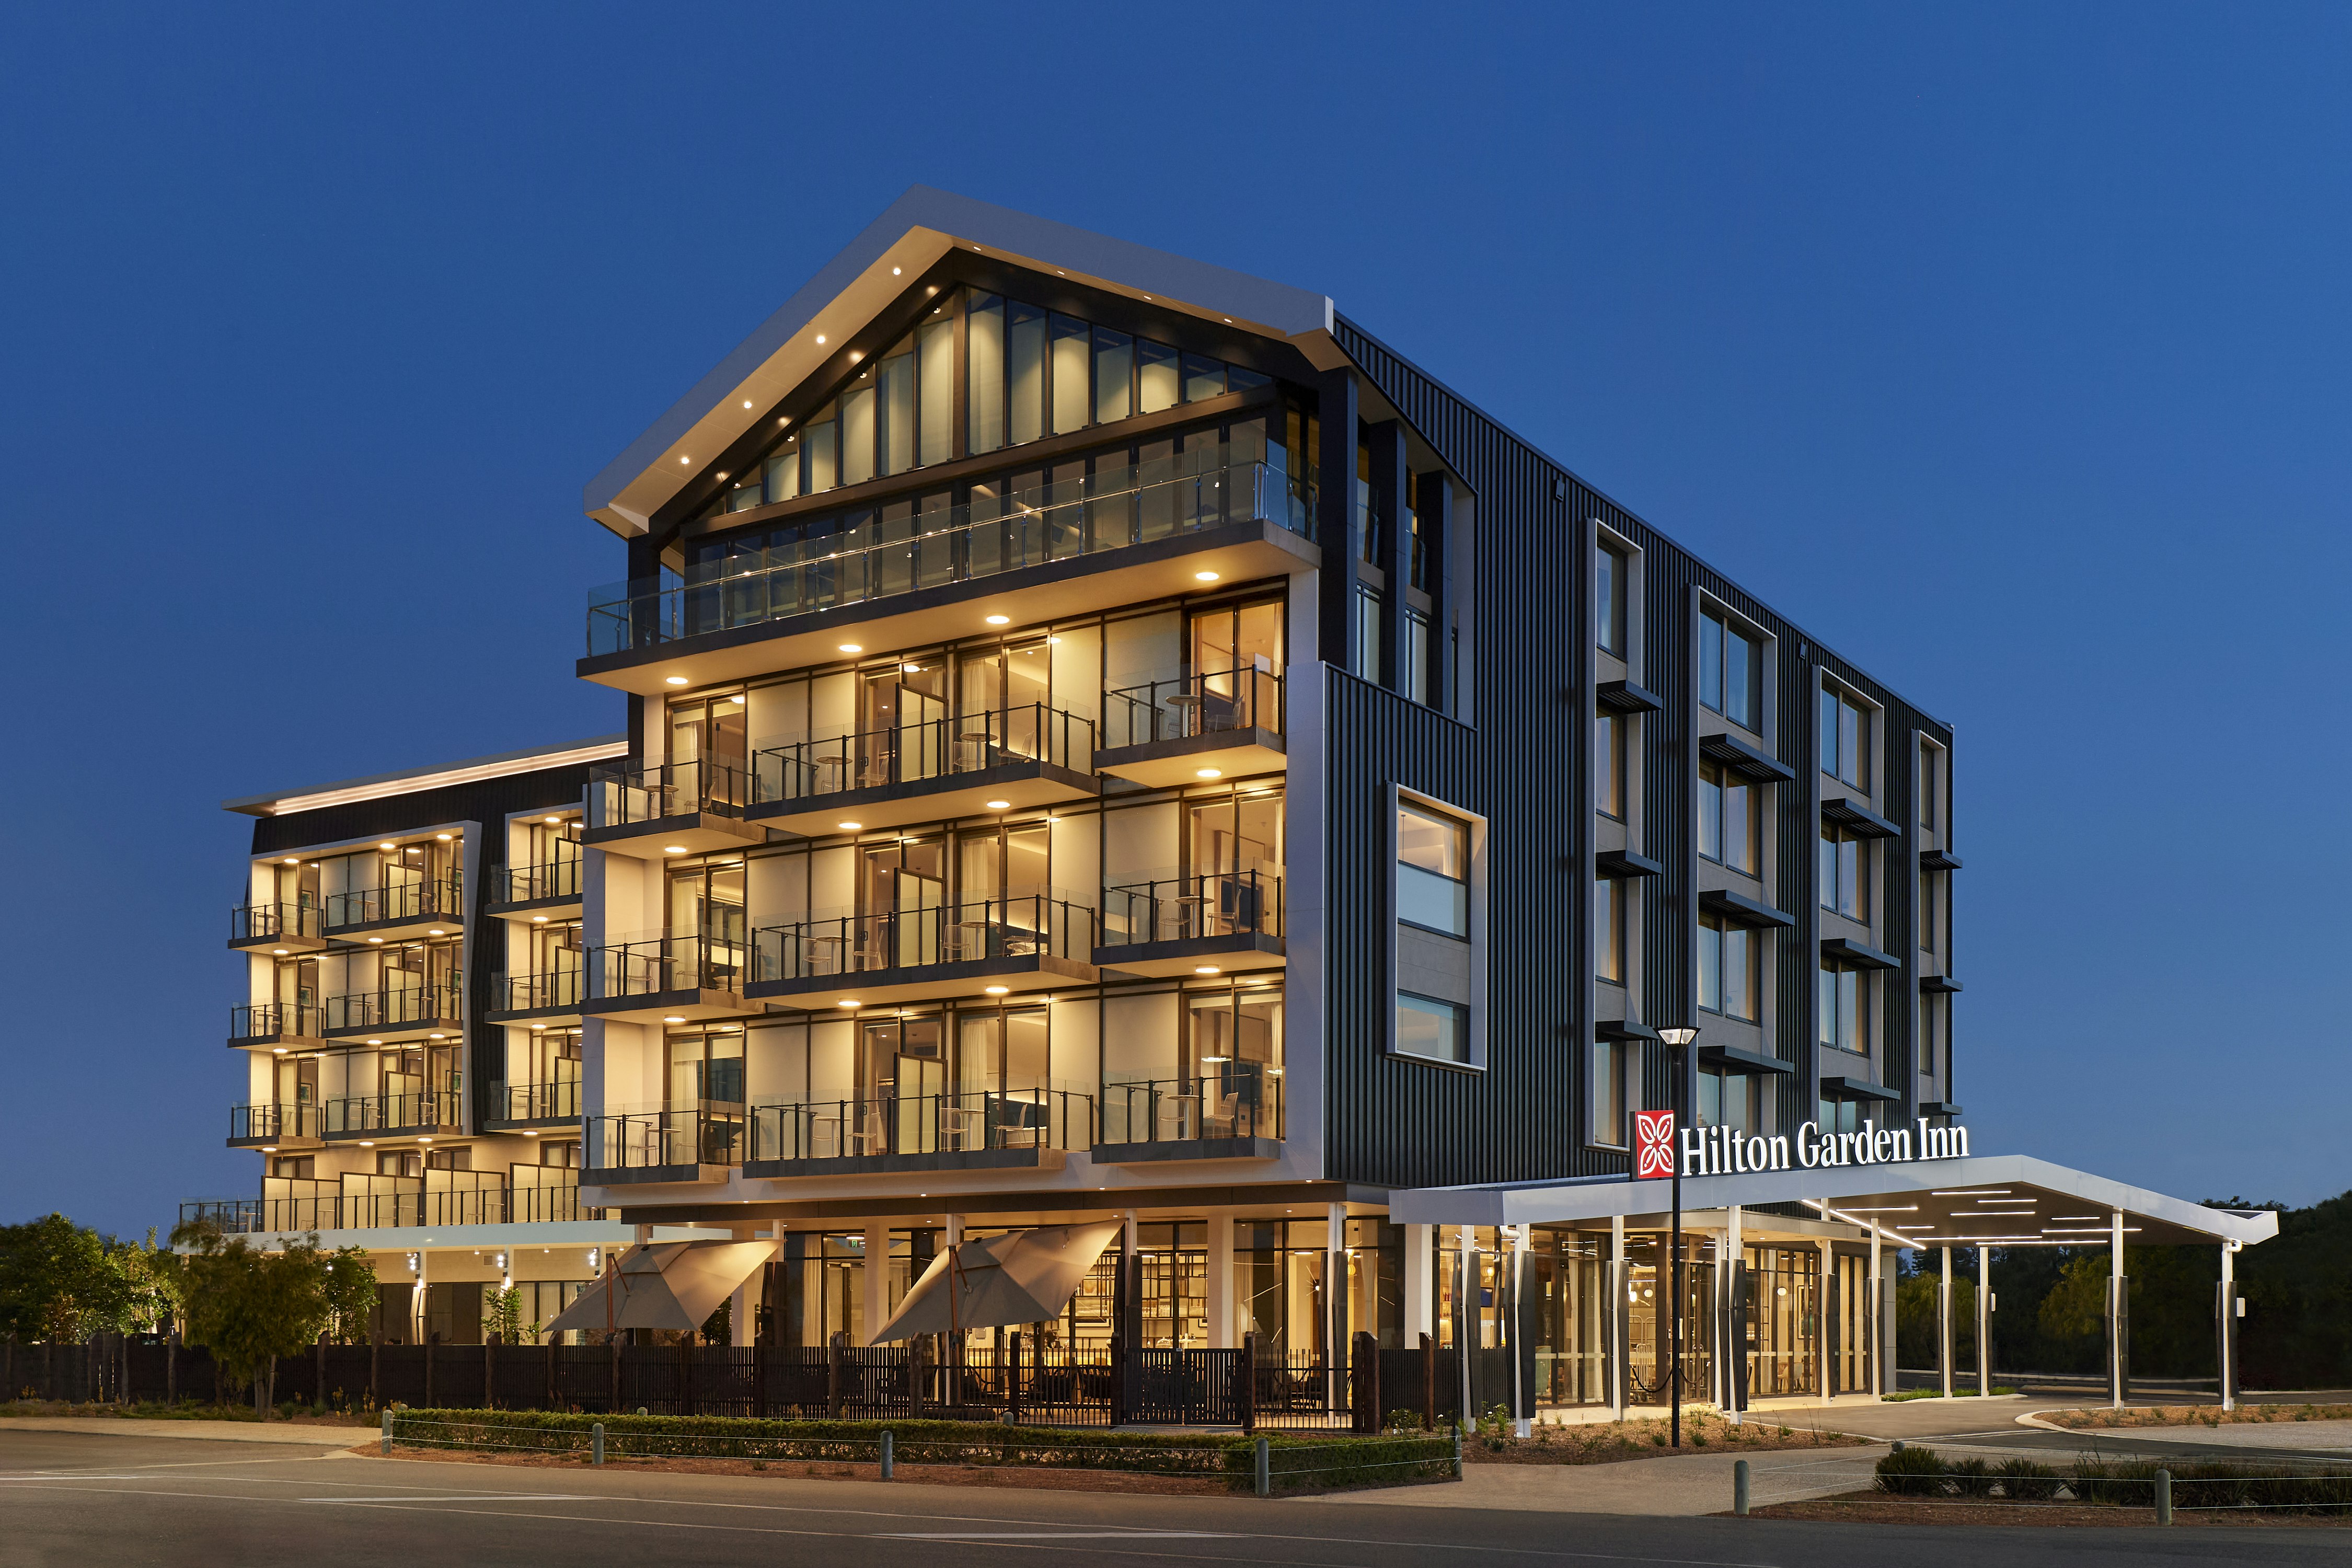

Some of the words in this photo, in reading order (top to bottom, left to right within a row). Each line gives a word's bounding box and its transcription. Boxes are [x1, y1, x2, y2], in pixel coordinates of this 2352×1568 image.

[1680, 1125, 1790, 1176] Hilton
[1797, 1120, 1913, 1167] Garden
[1917, 1117, 1970, 1160] Inn
